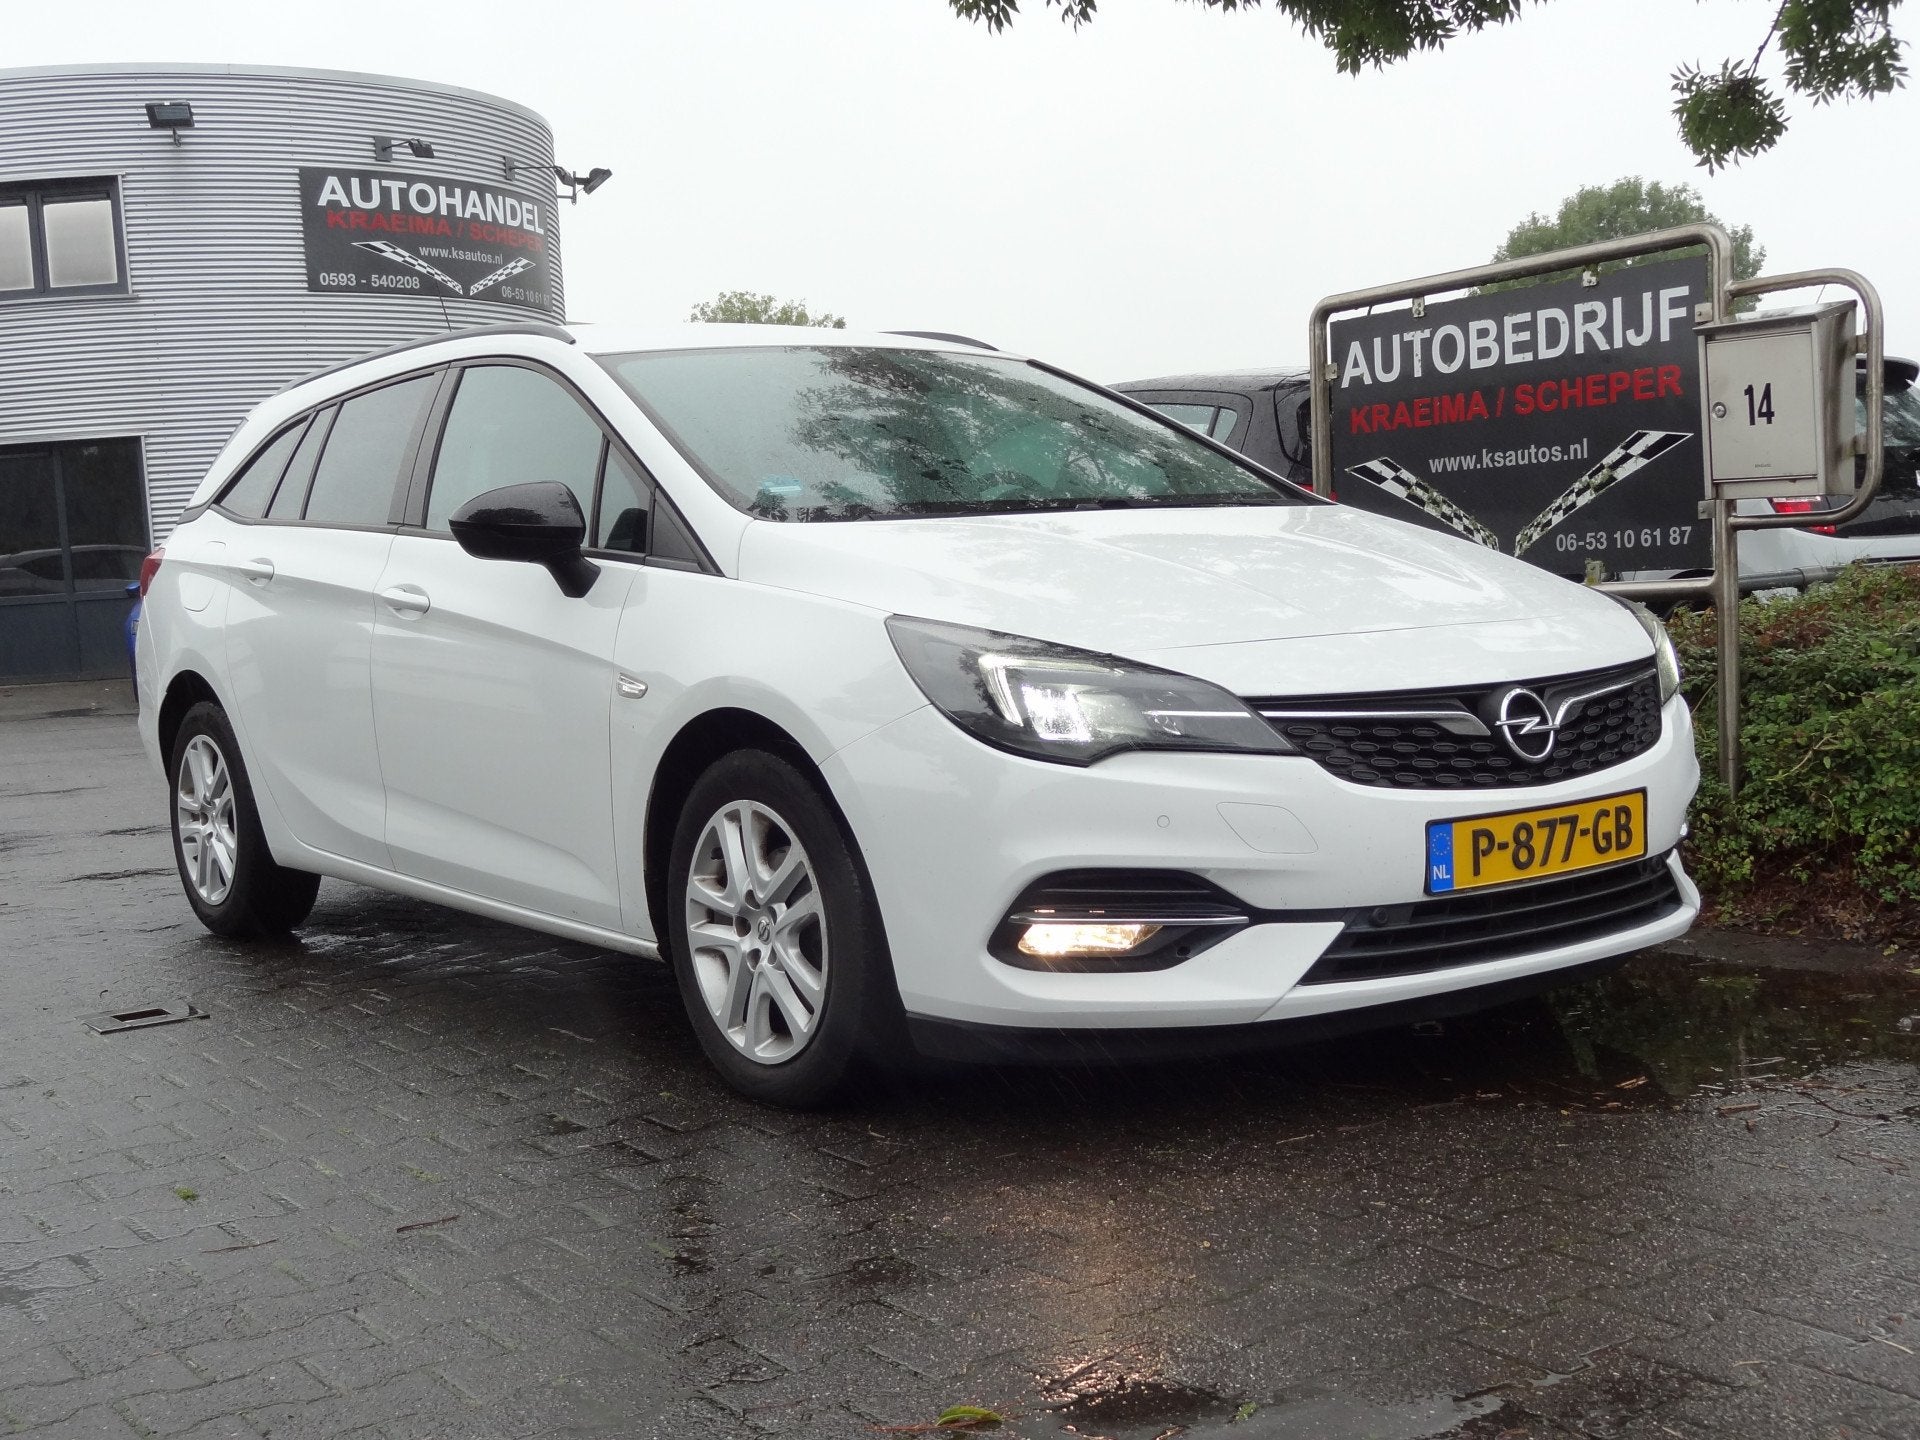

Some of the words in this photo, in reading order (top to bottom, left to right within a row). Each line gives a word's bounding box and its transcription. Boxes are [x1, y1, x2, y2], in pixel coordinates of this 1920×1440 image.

[317, 175, 544, 235] AUTOHANDEL
[326, 209, 451, 237] KRAEIMA
[468, 222, 543, 252] SCHEPER
[419, 245, 503, 265] www.ksautos.nl
[319, 272, 357, 287] 0593
[371, 274, 420, 289] 540208
[501, 285, 524, 300] 06-53
[525, 290, 535, 302] 10
[1341, 286, 1690, 388] AUTOBEDRIJF
[1350, 391, 1489, 433] KRAEIMA
[1514, 365, 1684, 415] SCHEPER
[1744, 382, 1775, 426] 14
[1429, 438, 1589, 473] www.ksautos.nl
[1556, 533, 1608, 552] 06-53
[1613, 530, 1636, 549] 10
[1640, 529, 1664, 548] 61
[1669, 526, 1692, 546] 87
[1472, 805, 1633, 877] P-877-GB
[1433, 865, 1451, 880] NL
